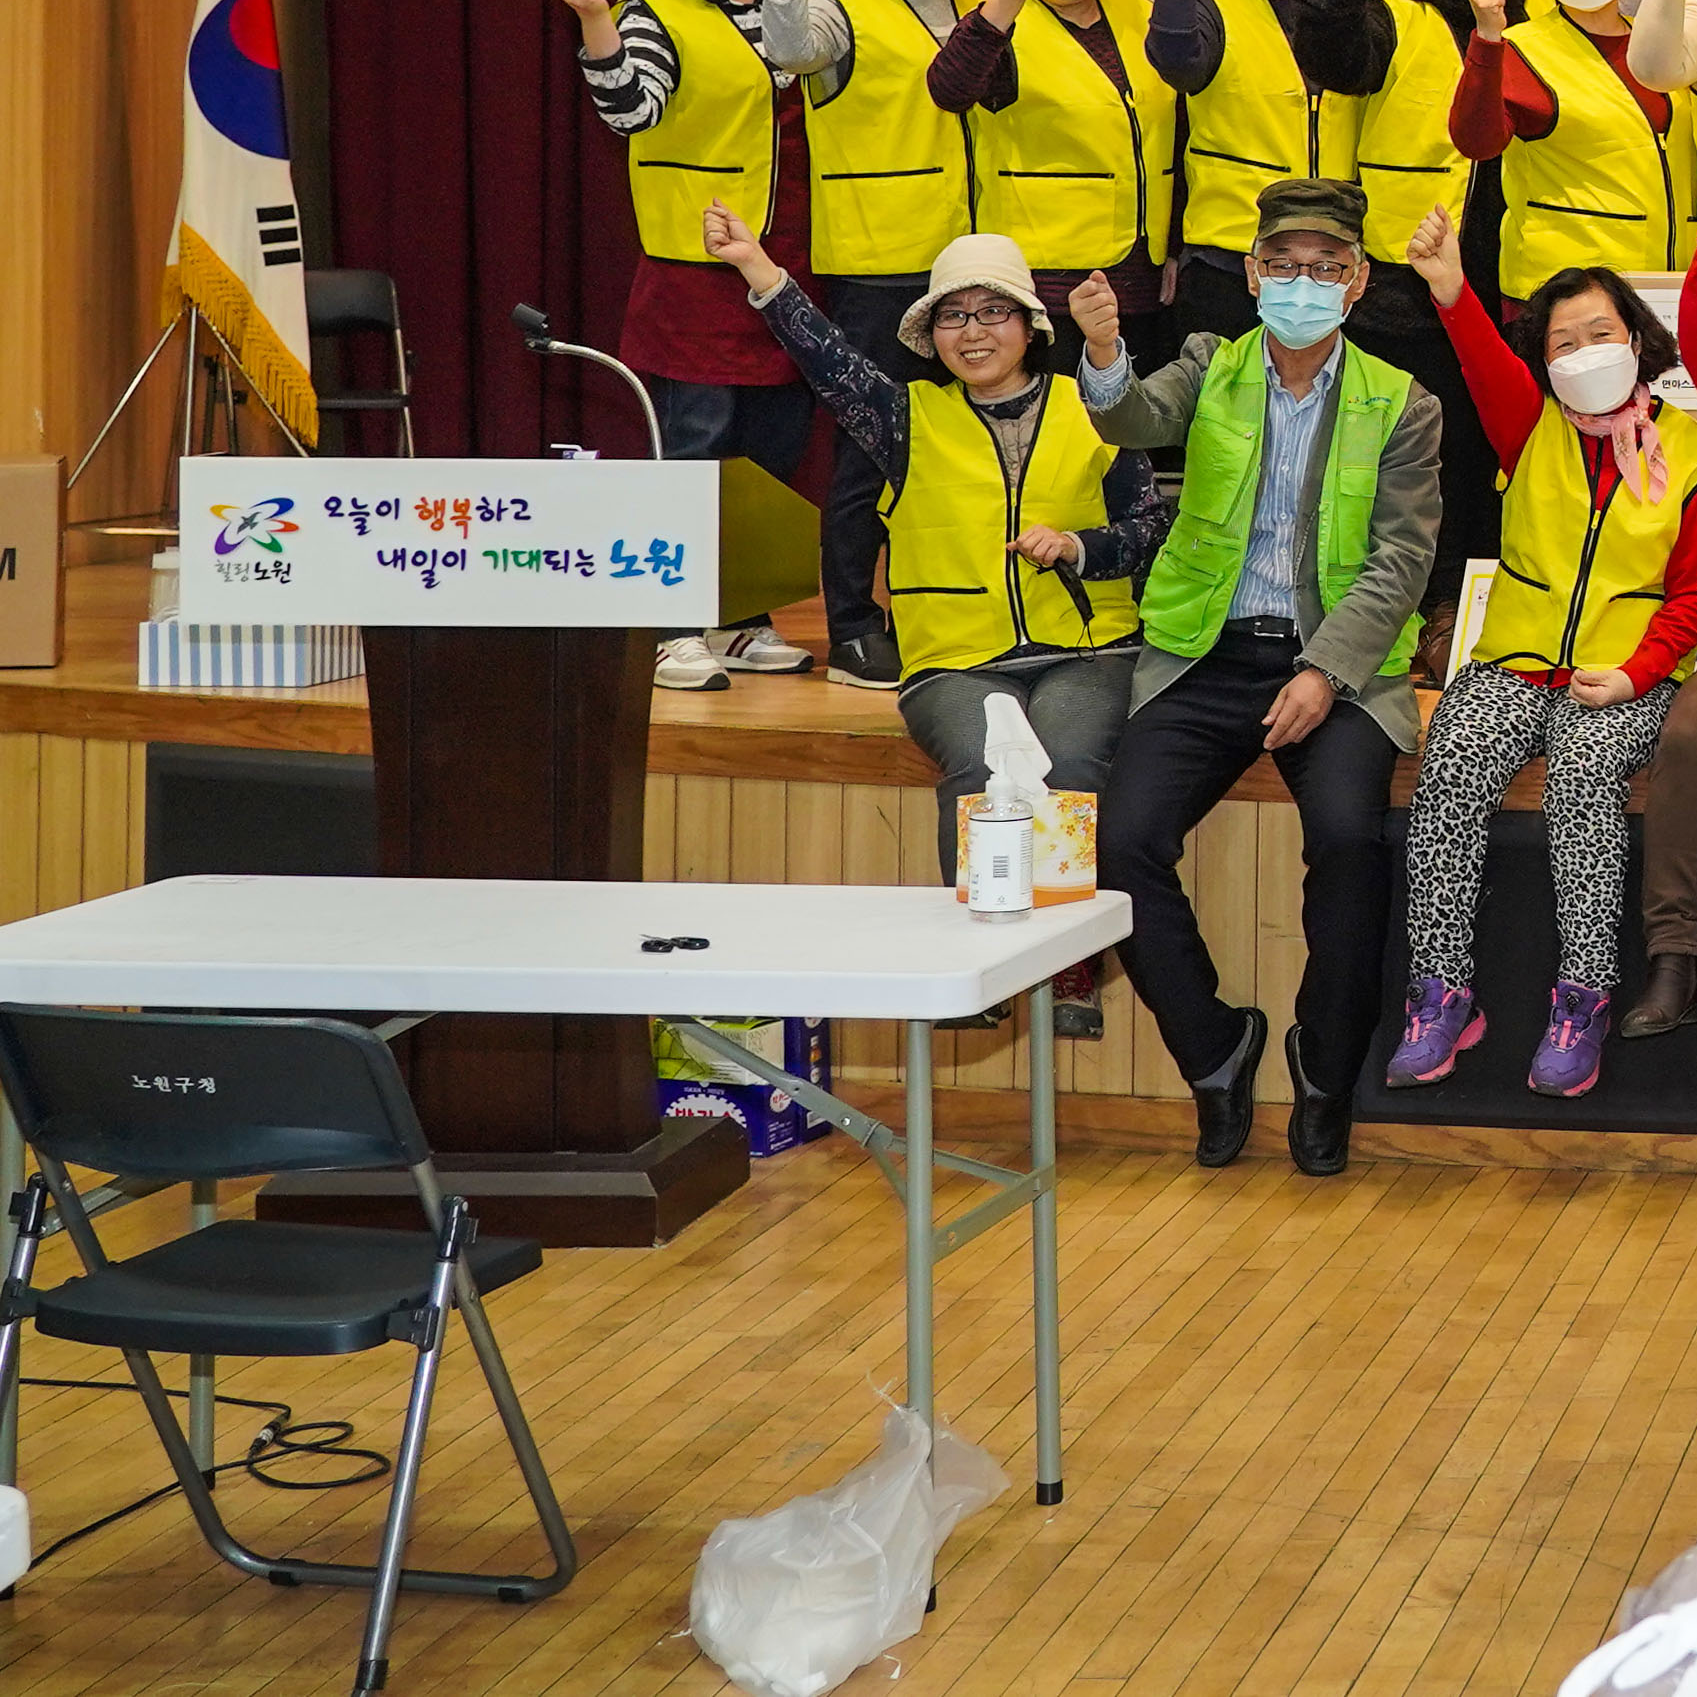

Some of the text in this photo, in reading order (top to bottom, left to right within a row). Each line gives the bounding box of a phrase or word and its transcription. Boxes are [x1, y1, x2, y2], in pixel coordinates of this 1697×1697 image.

[324, 496, 532, 539] 오늘이 행복하고
[376, 539, 687, 590] 내일이 기대되는 노원
[131, 1075, 218, 1095] 노원구청
